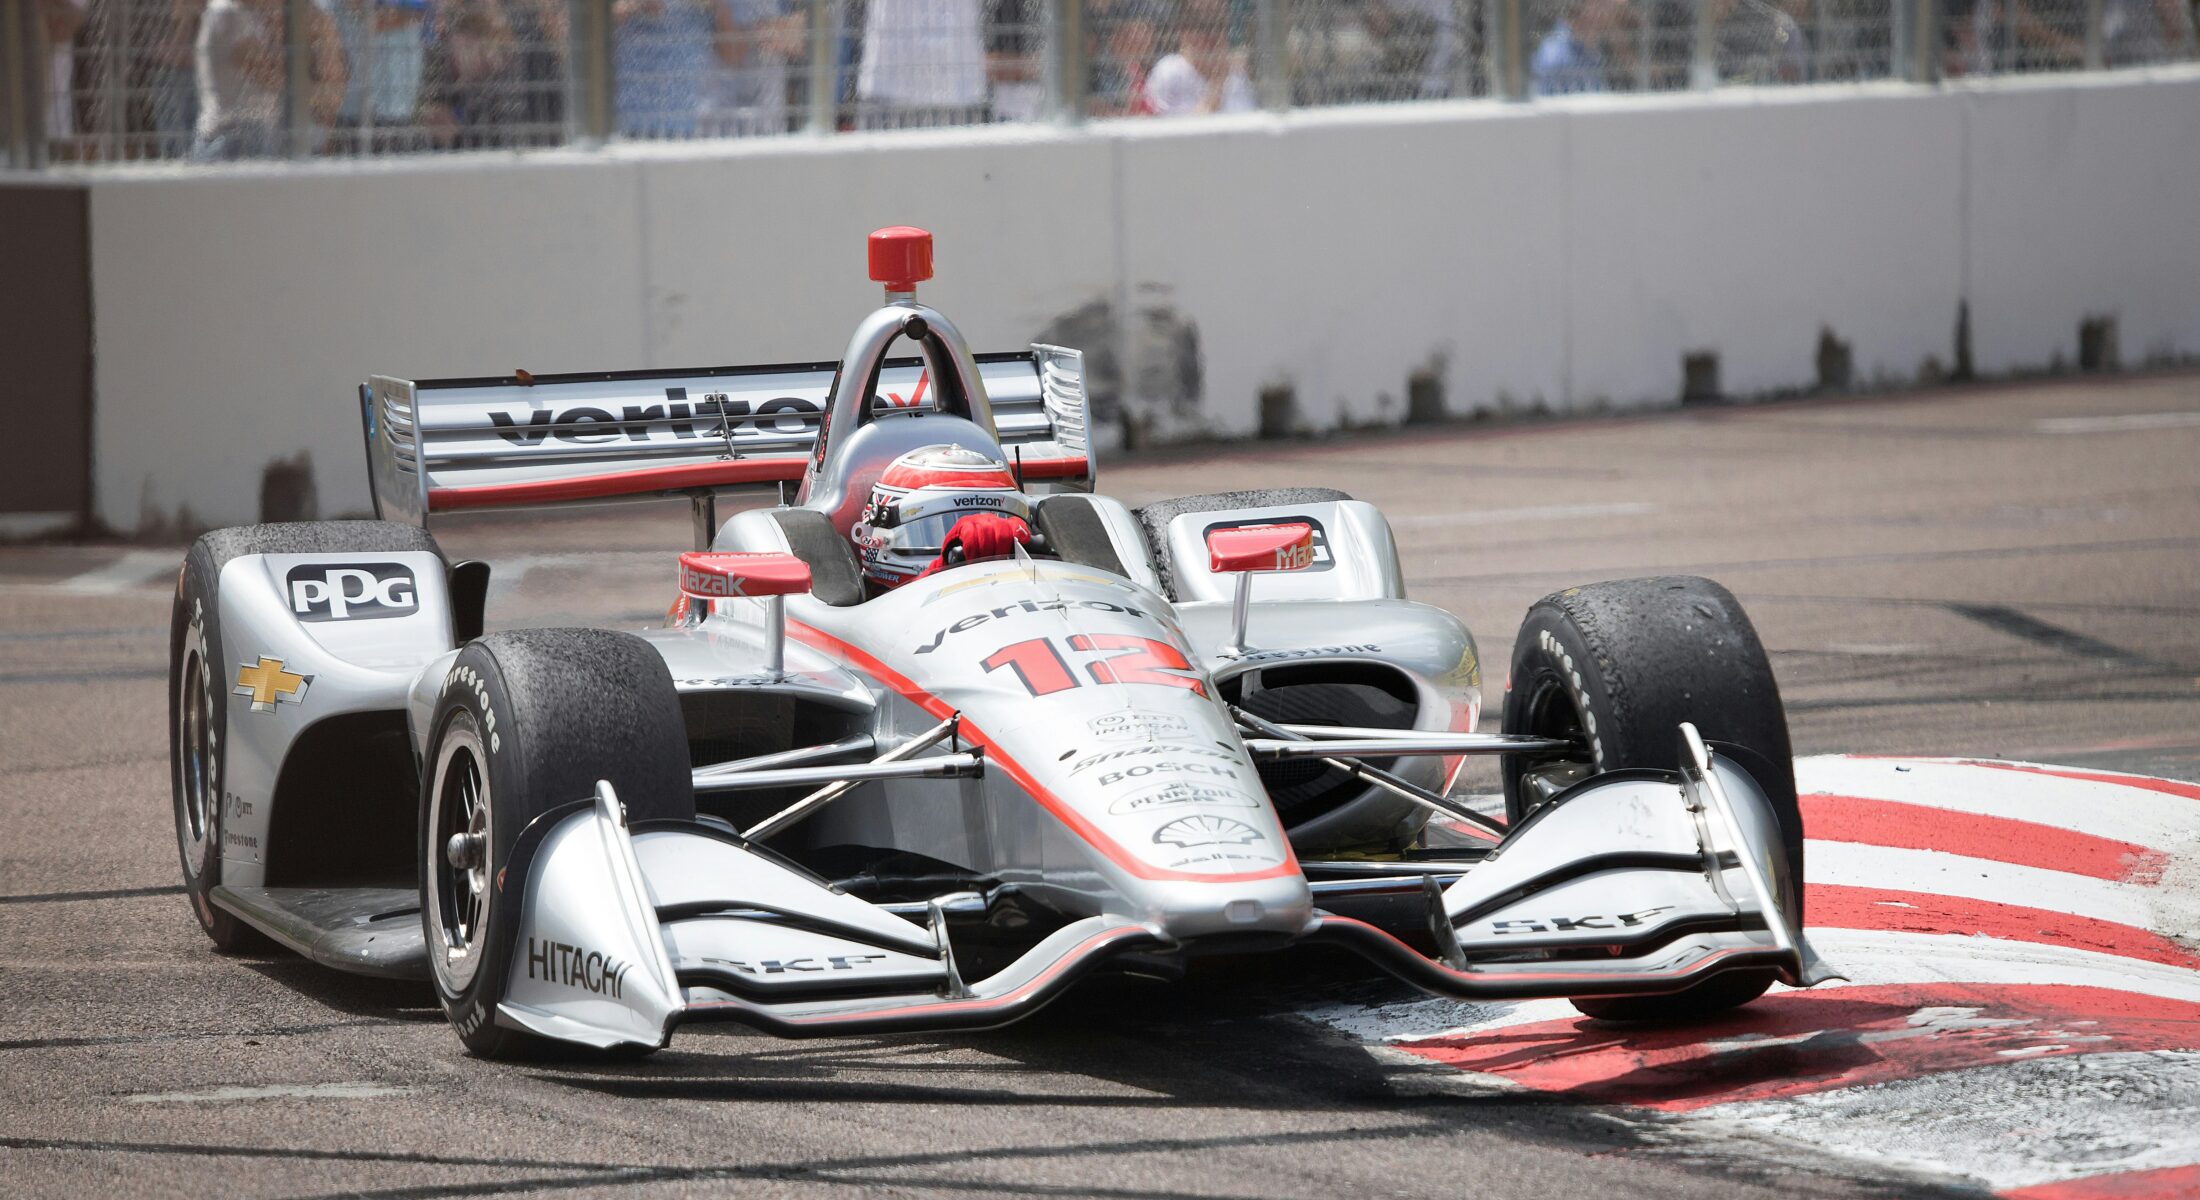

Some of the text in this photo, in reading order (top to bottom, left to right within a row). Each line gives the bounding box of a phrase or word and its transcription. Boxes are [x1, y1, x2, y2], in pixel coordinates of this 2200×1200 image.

[953, 495, 1001, 507] verizon
[292, 568, 415, 618] PPG
[680, 564, 748, 596] Mazak
[979, 633, 1210, 698] 12
[1216, 643, 1382, 662] Firestone
[442, 665, 500, 754] Firestone
[1098, 762, 1238, 787] BOSCH
[1130, 784, 1239, 808] PENNZOIL
[223, 828, 258, 849] Firestone
[1493, 905, 1675, 935] SKF
[528, 936, 633, 1000] HITACHI
